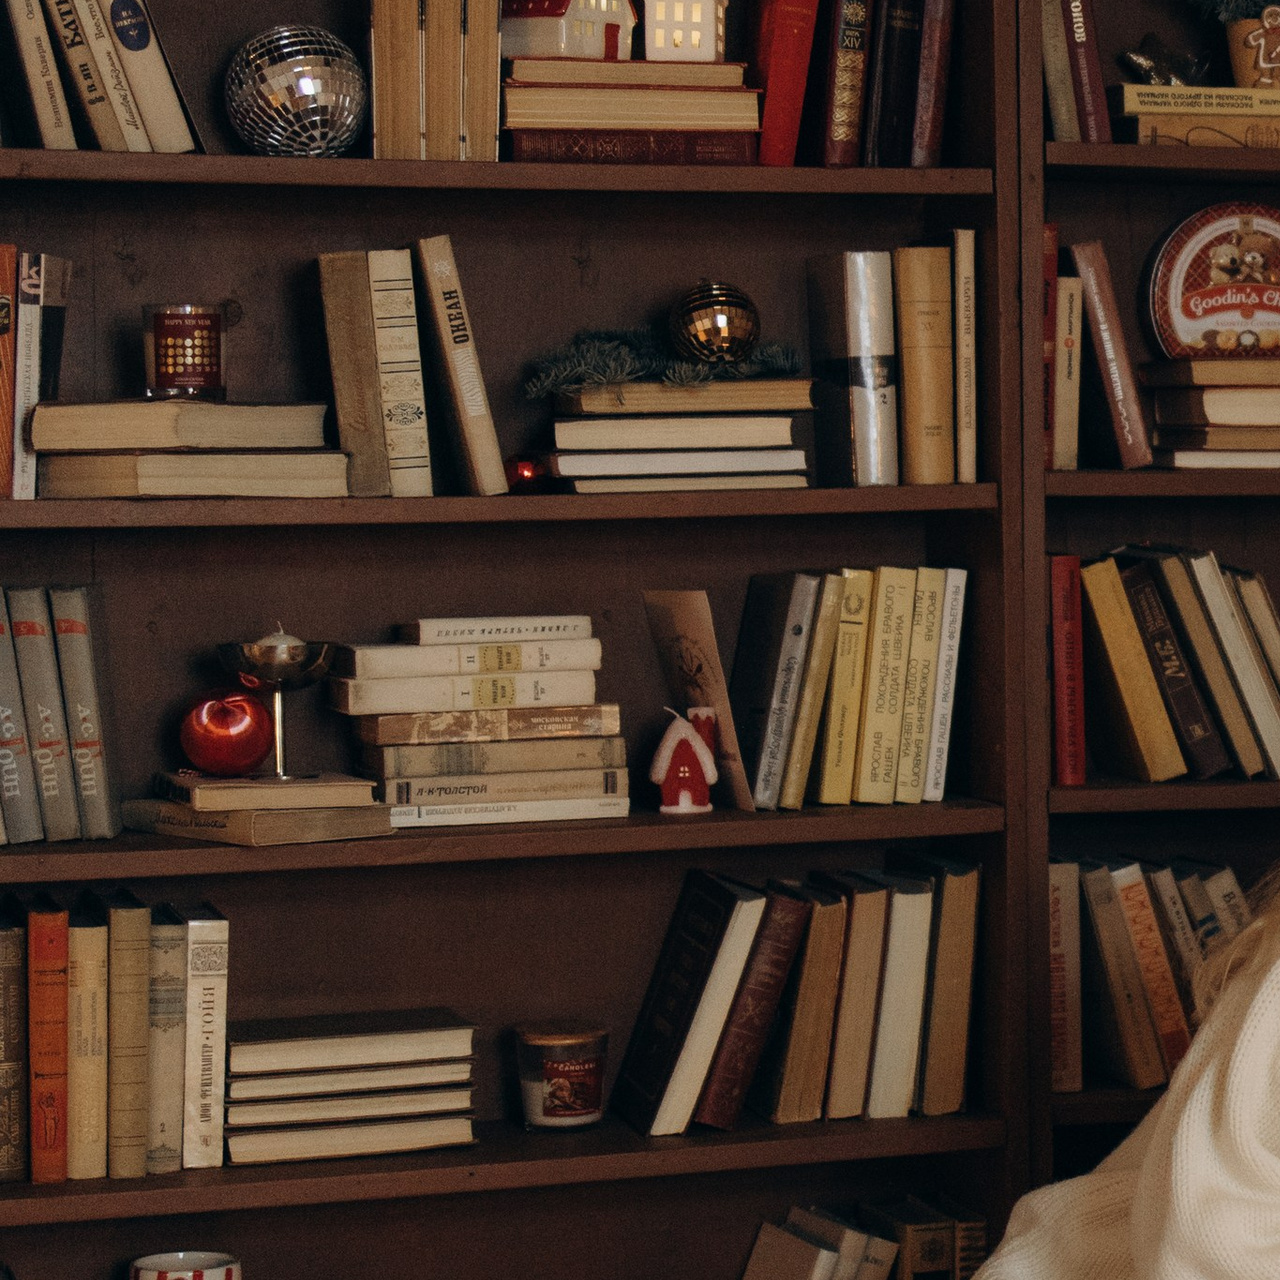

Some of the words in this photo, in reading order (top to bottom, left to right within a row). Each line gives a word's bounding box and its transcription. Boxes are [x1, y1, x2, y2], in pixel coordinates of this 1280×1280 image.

[30, 34, 52, 78] Каверин
[41, 78, 65, 129] Вениамин
[1134, 91, 1169, 100] КАРМАНА
[1137, 98, 1171, 107] КАРМАНА
[1170, 92, 1202, 100] ДРУГОГО
[1172, 99, 1201, 107] ОДНОГО
[1202, 93, 1213, 101] ИЗ
[1203, 100, 1212, 108] ИЗ
[1214, 93, 1253, 102] РАССКАЗЫ
[1214, 100, 1253, 109] РАССКАЗЫ
[439, 288, 470, 346] ОКЕАН
[1189, 287, 1259, 317] Goodin's
[882, 583, 895, 634] БРАВОГО
[912, 588, 925, 627] ГАШЕК
[923, 589, 938, 642] ЯРОСЛАВ
[946, 584, 960, 641] ФЕЛЬЕТОНЫ
[891, 614, 904, 661] ШВЕЙКА
[875, 638, 891, 714] ПОХОЖДЕНИЯ
[888, 665, 900, 715] СОЛДАТА
[905, 656, 919, 708] СОЛДАТА
[914, 657, 931, 736] ПОХОЖДЕНИЯ
[940, 654, 954, 703] РАССКАЗЫ
[538, 723, 572, 731] старина
[901, 710, 914, 758] ШВЕЙКА
[936, 711, 948, 744] ГАШЕК
[870, 730, 883, 783] ЯРОСЛАВ
[882, 745, 894, 784] ГАШЕК
[909, 738, 923, 788] БРАВОГО
[932, 745, 945, 791] ЯРОСЛАВ
[202, 986, 216, 1035] ГОЙЯ
